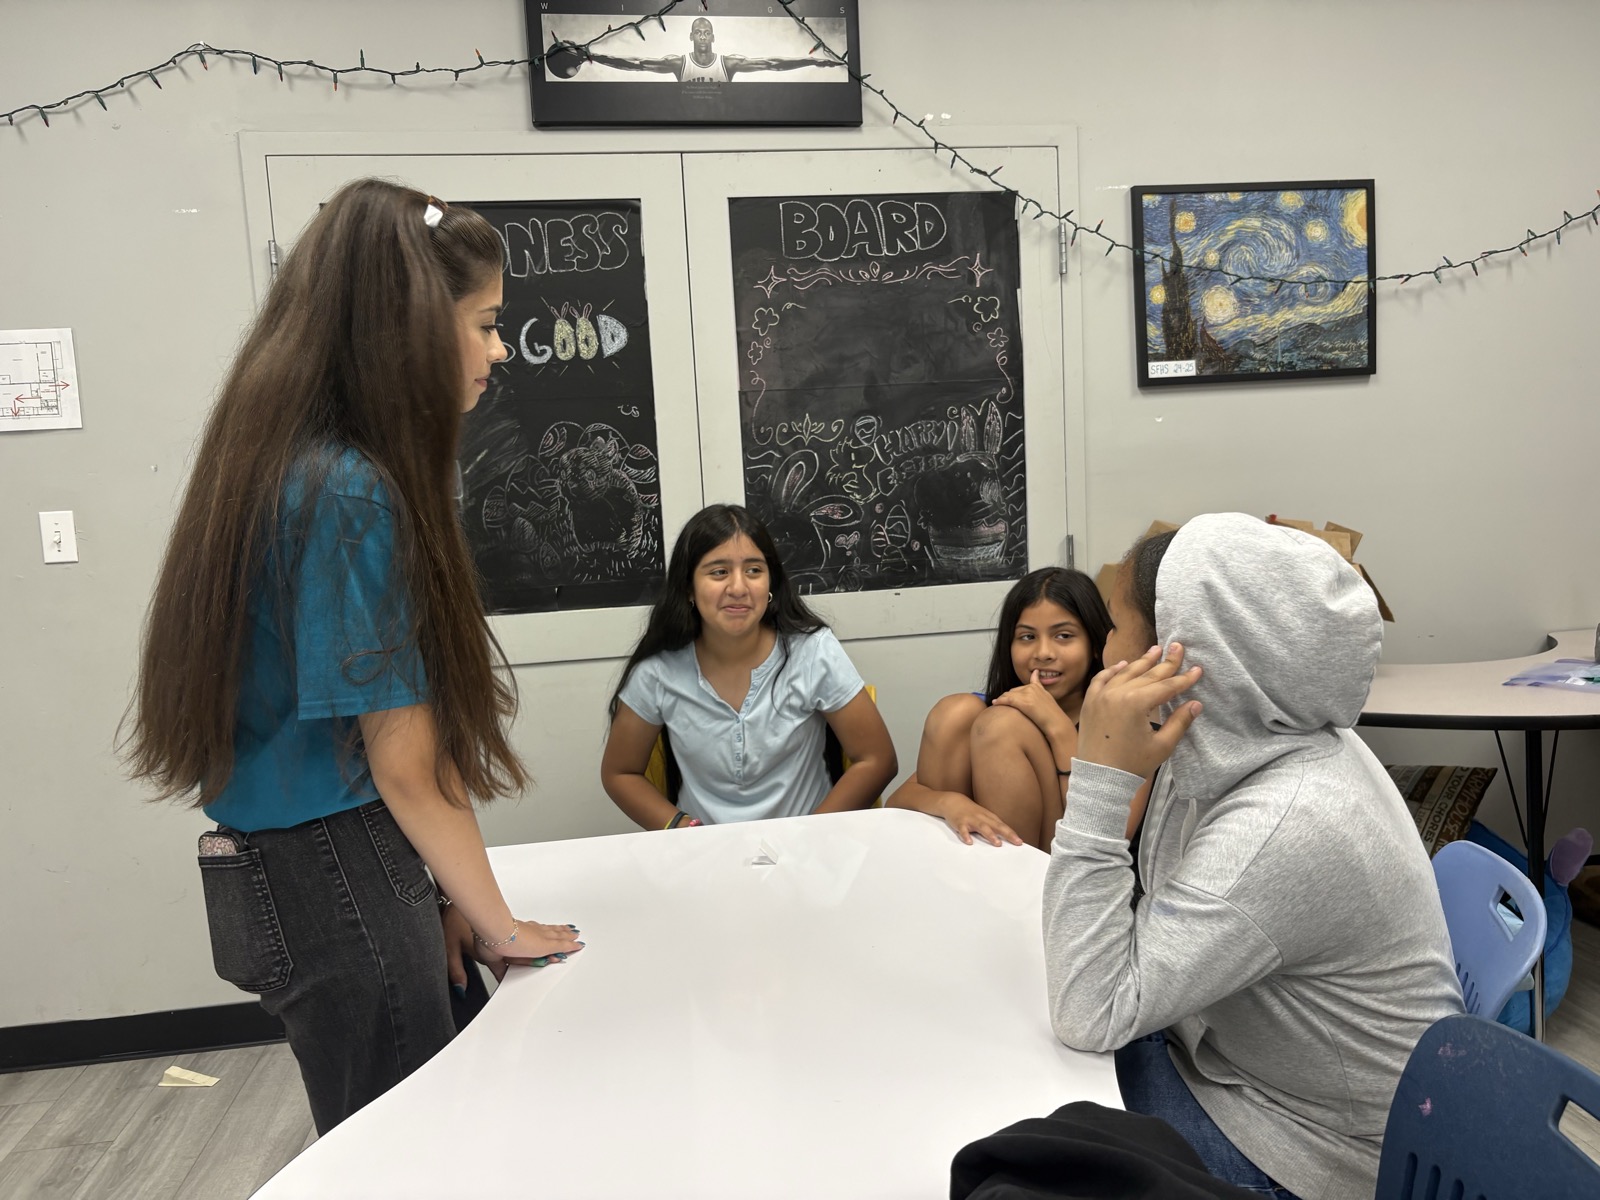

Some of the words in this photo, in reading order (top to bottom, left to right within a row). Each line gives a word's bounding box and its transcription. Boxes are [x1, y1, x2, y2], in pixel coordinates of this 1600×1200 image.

[494, 211, 630, 278] NESS
[779, 199, 947, 262] BOARD
[519, 311, 630, 365] GOOD
[1443, 775, 1463, 800] YOUR
[1424, 802, 1449, 843] CHORES
